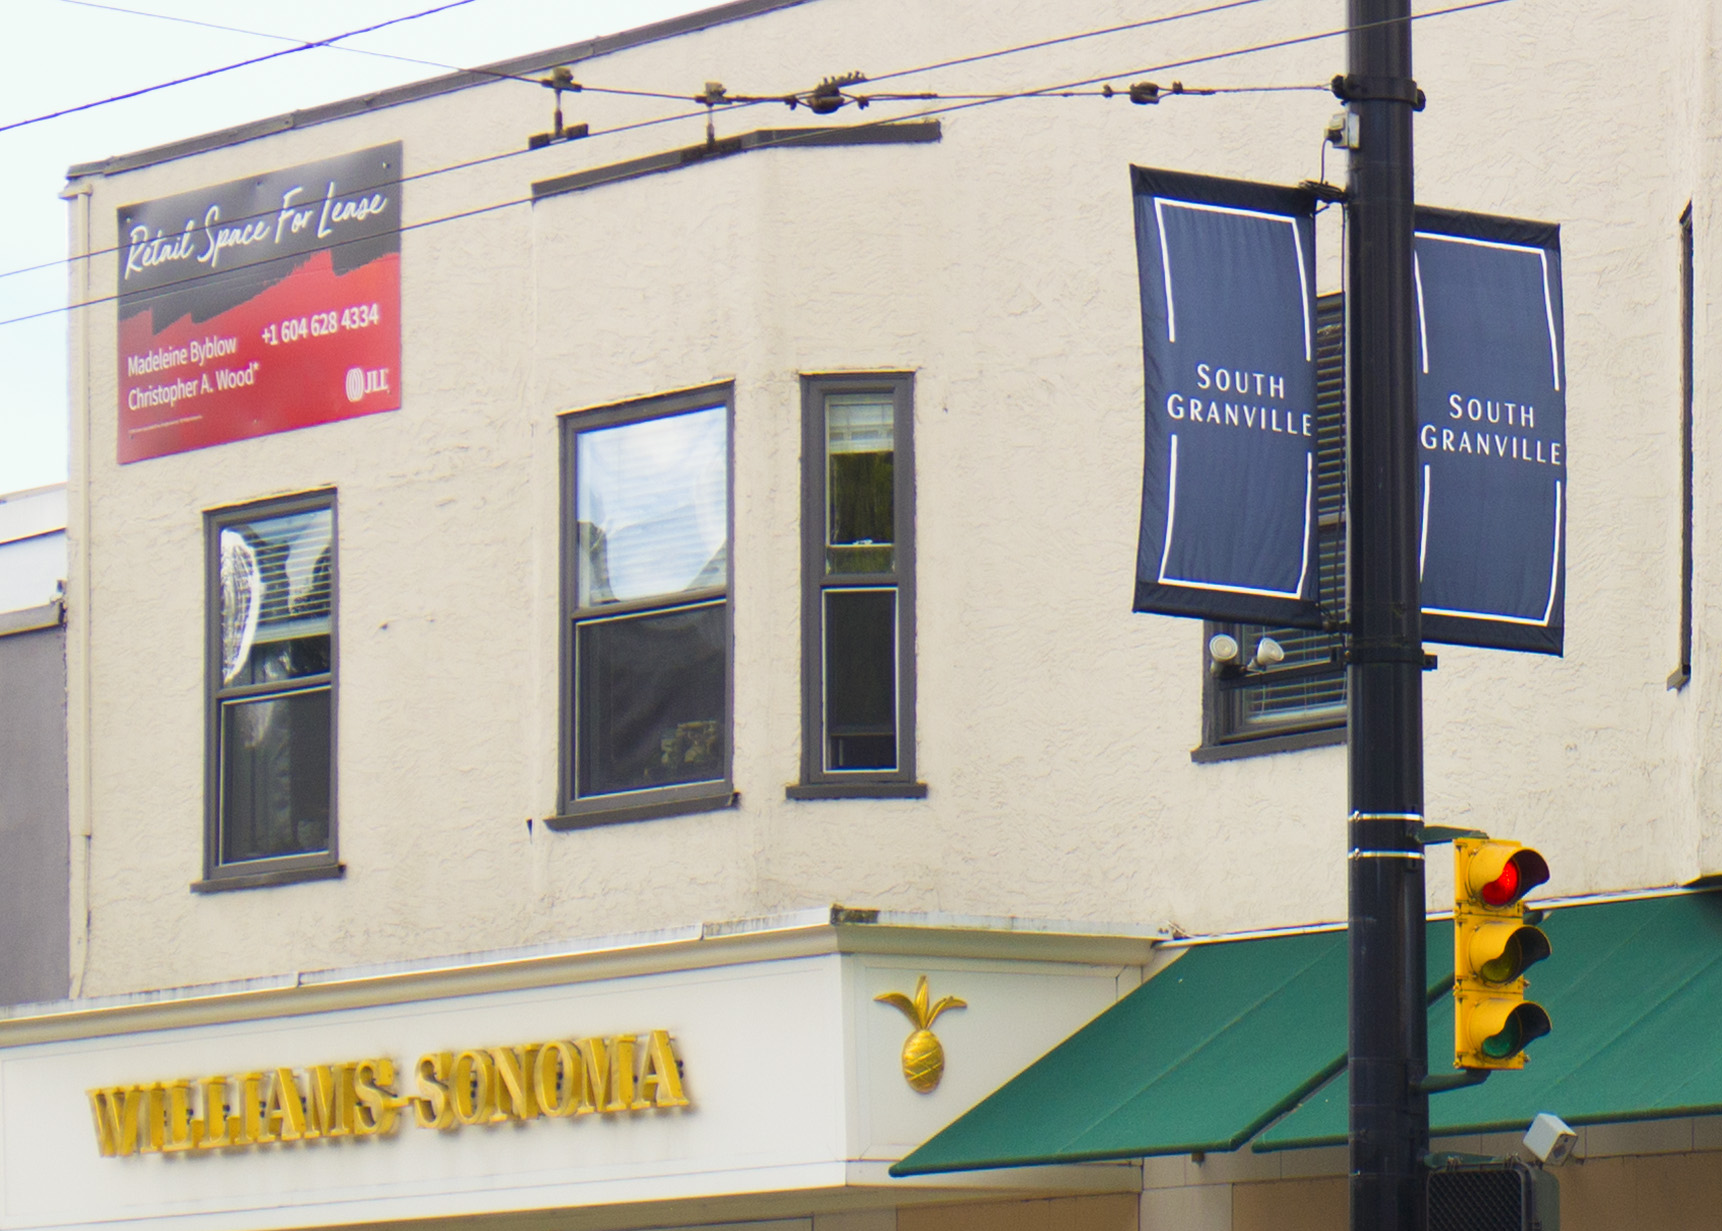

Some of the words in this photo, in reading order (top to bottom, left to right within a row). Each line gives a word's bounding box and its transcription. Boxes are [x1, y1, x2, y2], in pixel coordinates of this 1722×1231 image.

[124, 219, 195, 280] Retail
[197, 205, 271, 268] Space
[274, 186, 315, 243] For
[317, 181, 388, 239] Lease
[261, 323, 279, 346] +1
[281, 317, 308, 342] 604
[310, 311, 338, 337] 628
[341, 302, 379, 330] 4334
[127, 345, 188, 377] Madeleine
[190, 335, 237, 367] Byblow
[128, 377, 198, 411] Christopher
[200, 373, 214, 395] A.
[364, 368, 389, 394] JLL
[1196, 363, 1286, 399] SOUTH
[1166, 393, 1312, 437] GRANVILLE
[1448, 394, 1535, 429] SOUTH
[1420, 424, 1562, 466] GRANVILLE
[85, 1028, 692, 1159] WILLIAMS-SONOMA
